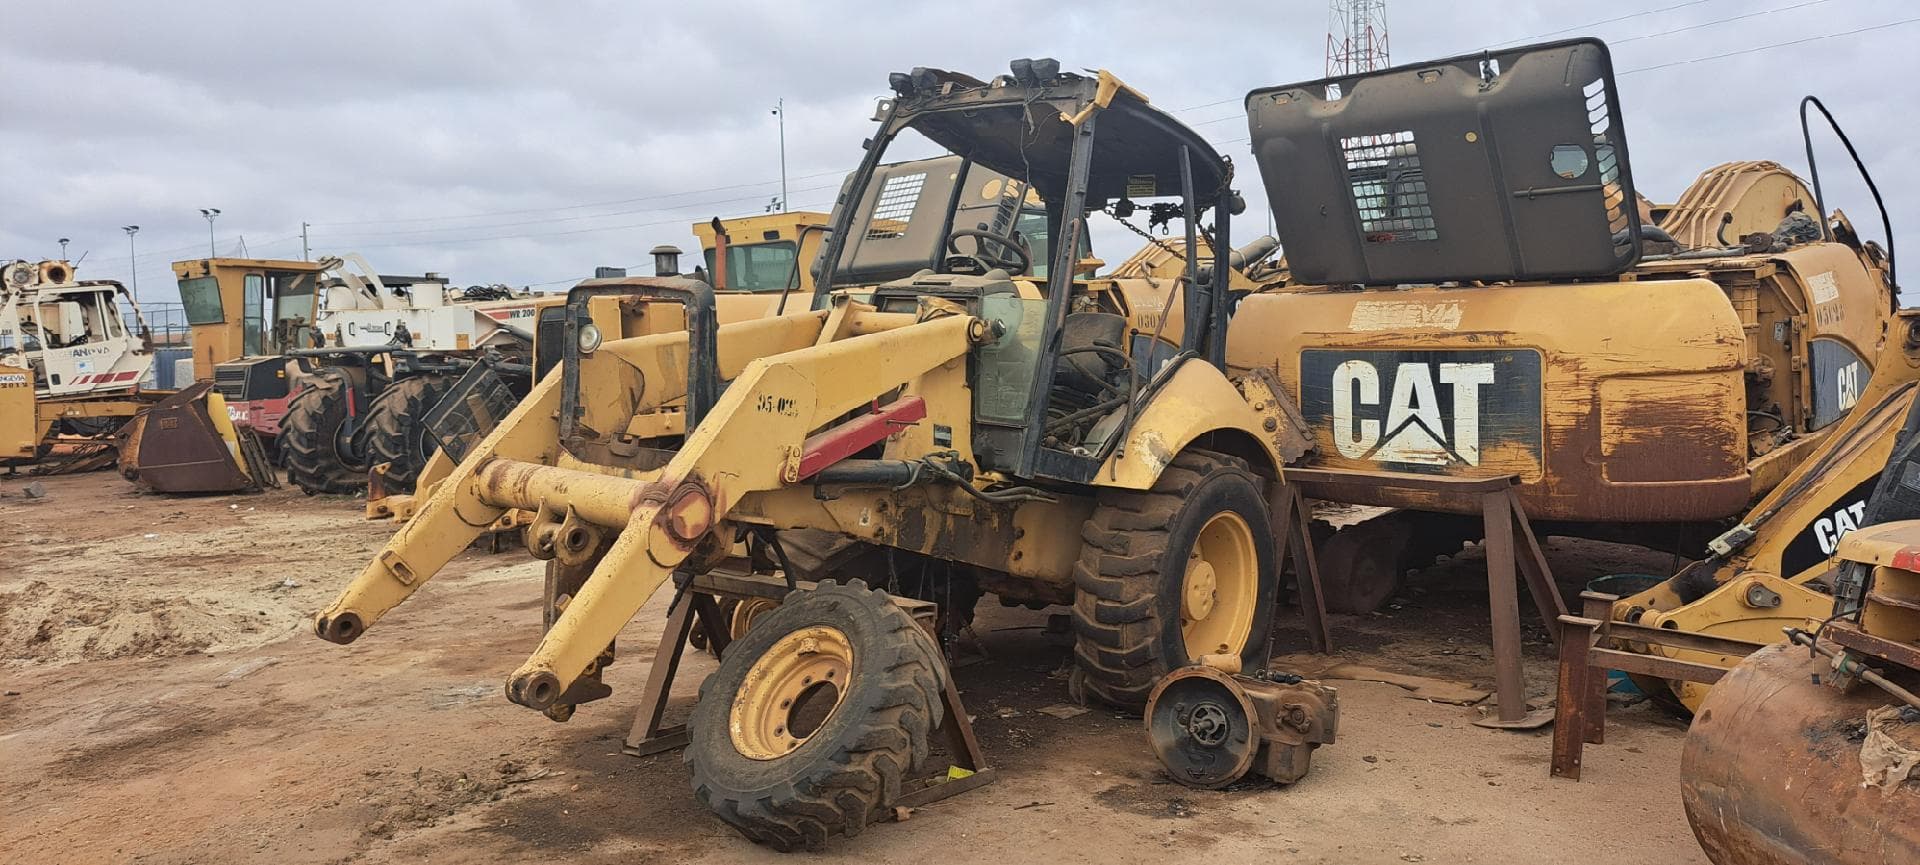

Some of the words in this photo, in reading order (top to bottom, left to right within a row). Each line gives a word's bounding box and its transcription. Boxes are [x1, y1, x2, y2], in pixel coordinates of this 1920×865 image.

[1333, 360, 1494, 466] CAT
[1838, 361, 1857, 411] CAT
[1814, 500, 1866, 554] CAT
